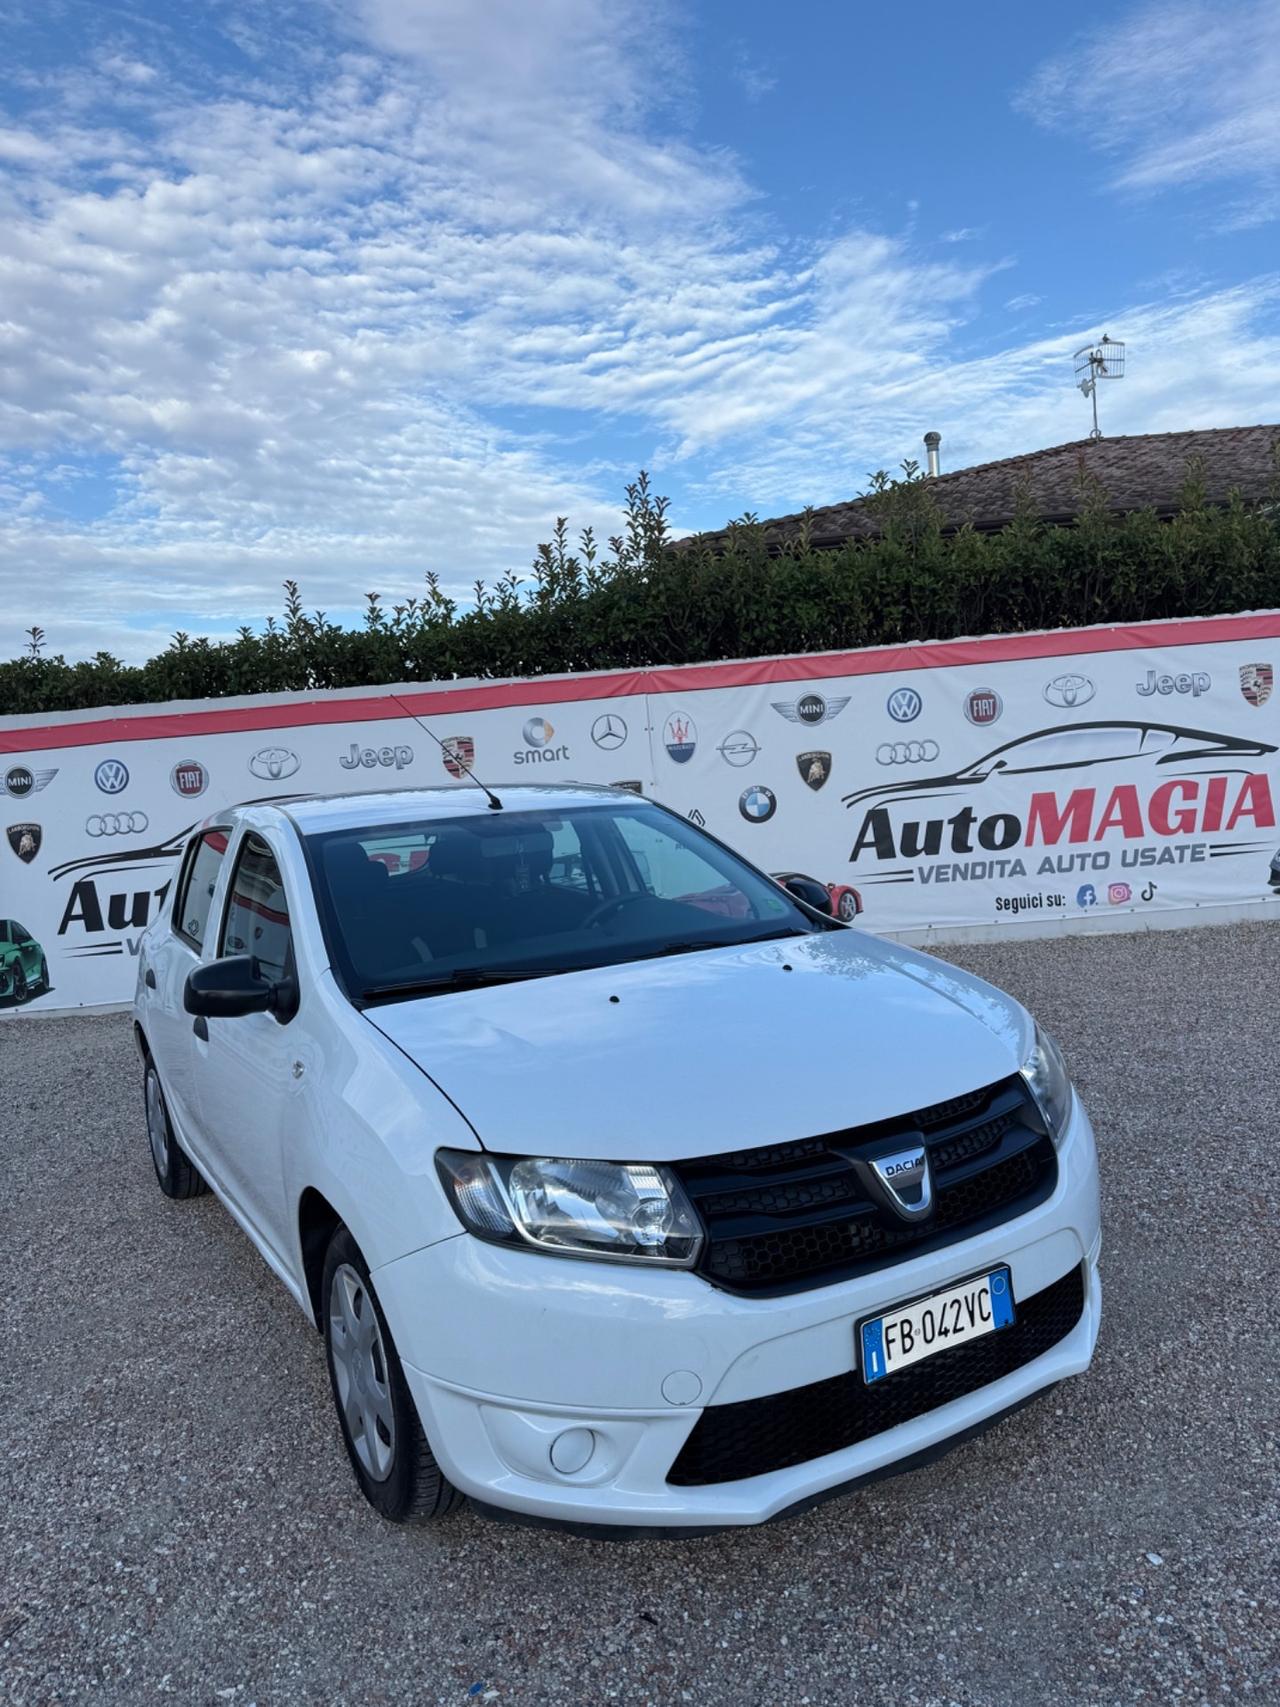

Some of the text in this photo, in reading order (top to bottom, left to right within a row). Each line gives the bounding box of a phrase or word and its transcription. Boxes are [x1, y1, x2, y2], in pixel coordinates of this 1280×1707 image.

[1136, 670, 1212, 697] Jeep
[800, 704, 824, 714] MINI
[973, 700, 995, 716] FIAT
[340, 744, 414, 770] Jeep
[513, 745, 570, 764] smart
[8, 776, 31, 786] MINI
[179, 771, 201, 788] FIAT
[918, 843, 1207, 885] VENDITA AUTO USATE
[995, 892, 1066, 914] Seguici su:
[885, 1156, 926, 1177] DACIA
